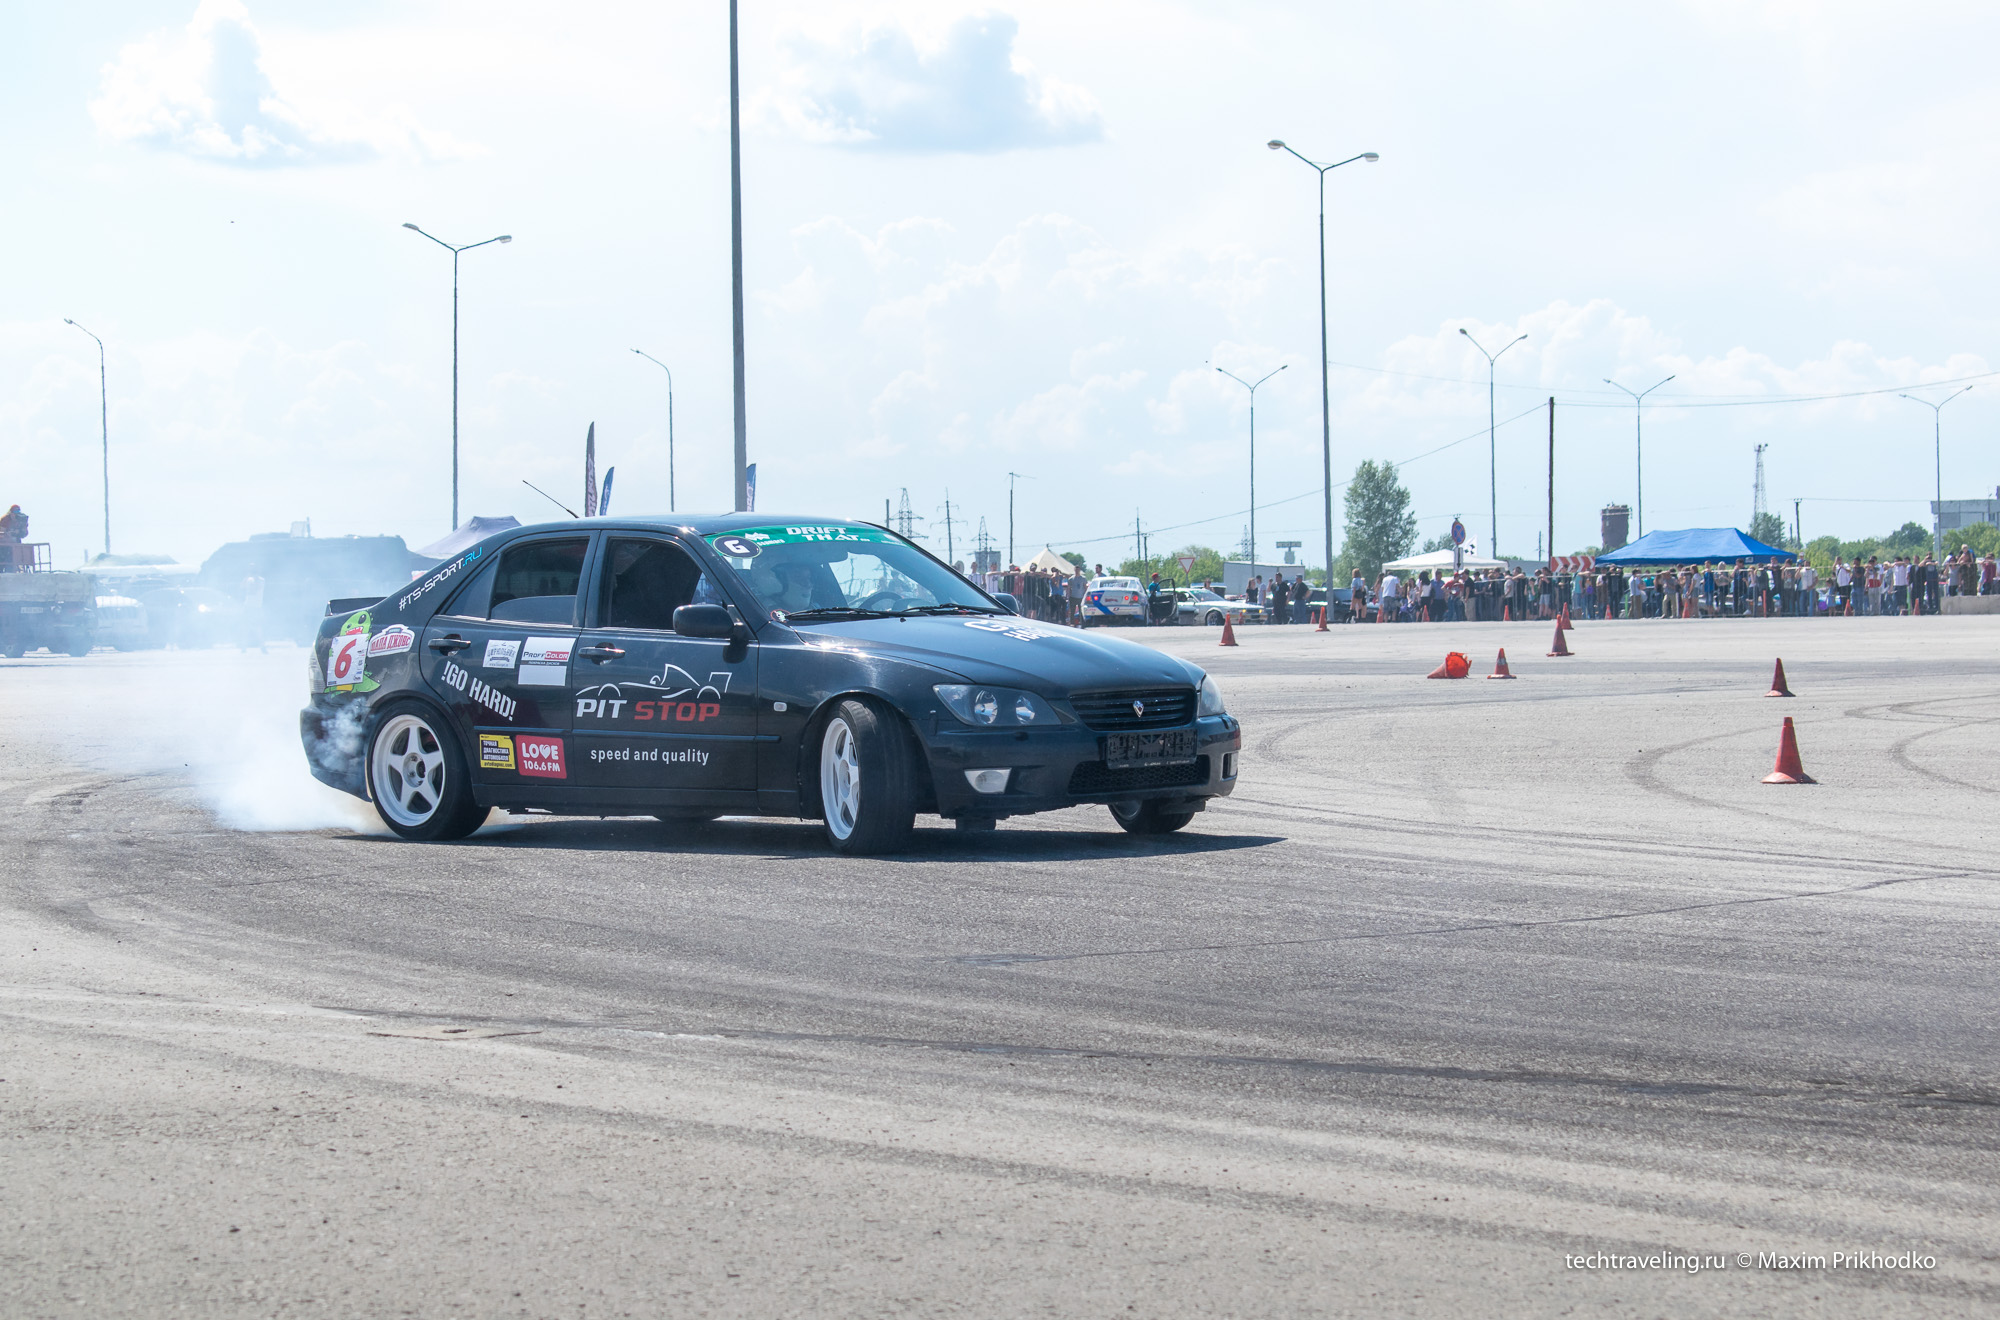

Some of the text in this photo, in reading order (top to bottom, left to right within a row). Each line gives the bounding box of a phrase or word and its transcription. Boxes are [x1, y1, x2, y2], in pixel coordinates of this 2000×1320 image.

[786, 527, 847, 535] DRIFT
[724, 540, 750, 553] G
[399, 547, 482, 611] #TS-SPORT.RU
[335, 639, 357, 678] 6
[441, 661, 517, 721] !GO HARD!
[576, 699, 720, 721] PIT STOP
[523, 760, 561, 772] 106.6 FM
[590, 747, 709, 766] speed and quality
